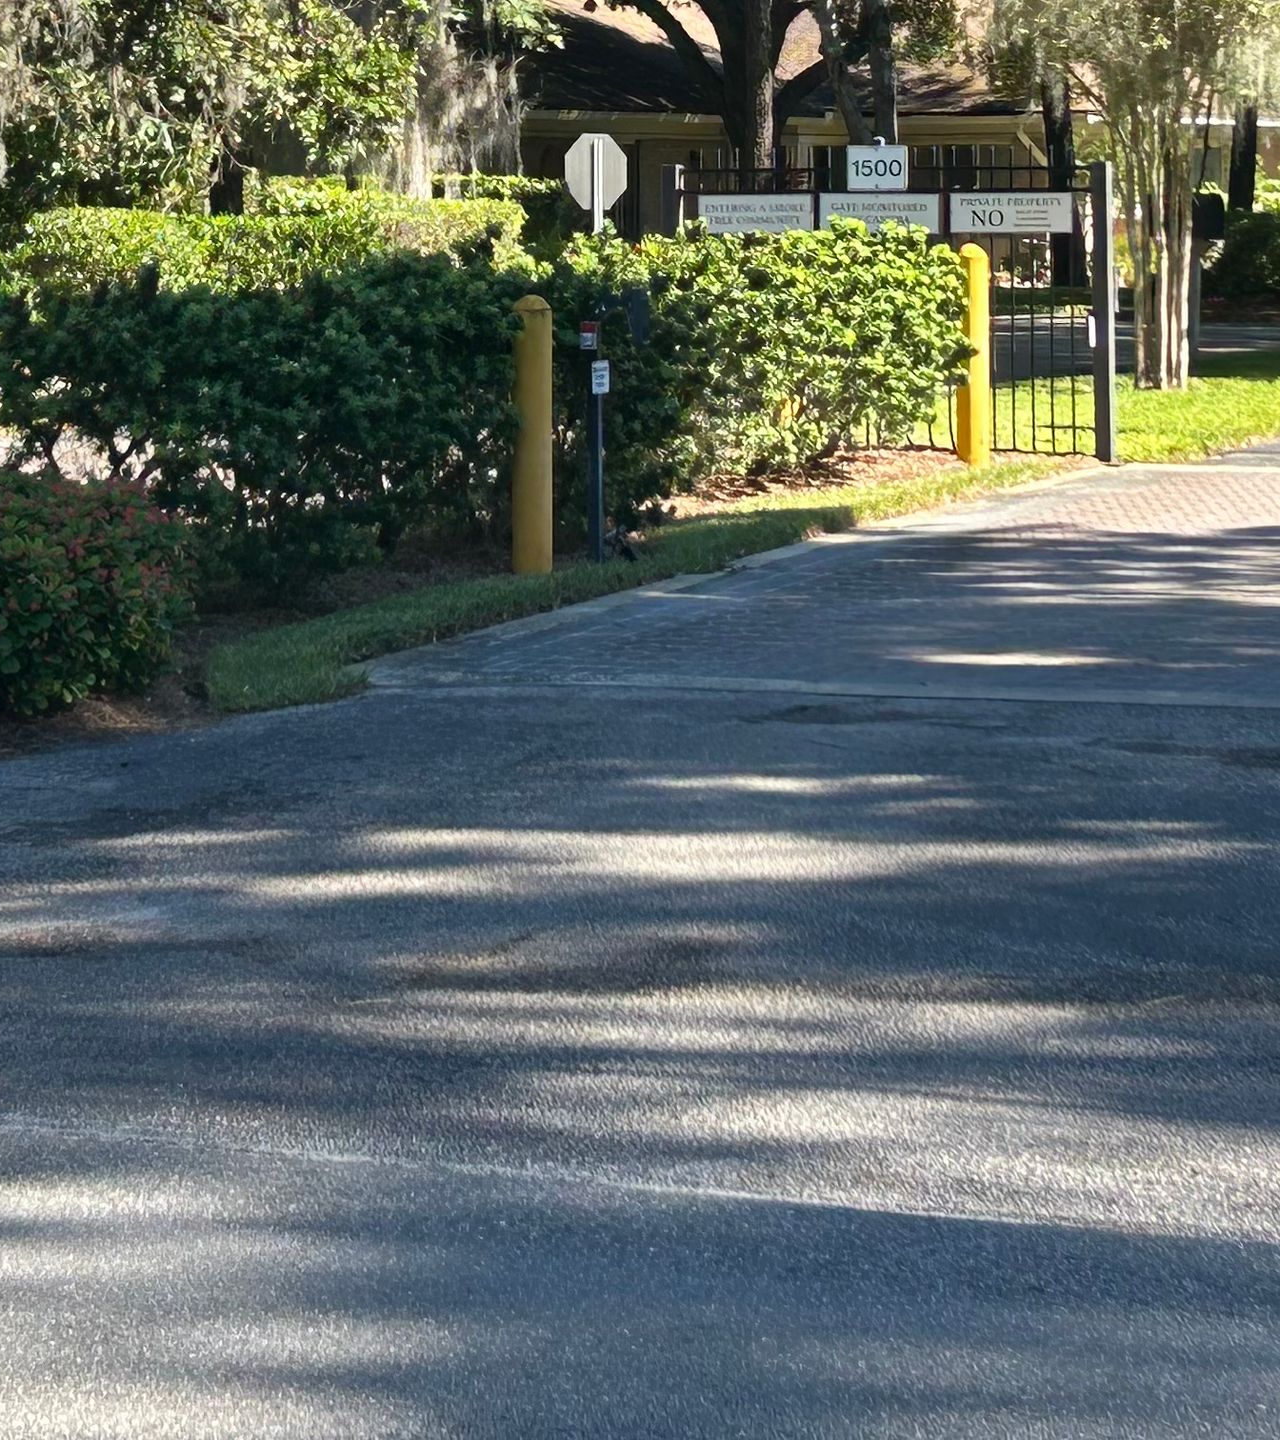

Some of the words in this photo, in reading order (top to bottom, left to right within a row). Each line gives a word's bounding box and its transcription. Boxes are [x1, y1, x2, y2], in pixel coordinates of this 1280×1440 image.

[852, 160, 902, 177] 1500
[960, 197, 1003, 206] PRIVATE
[1007, 197, 1061, 206] PROPERTY
[971, 209, 1004, 227] NO
